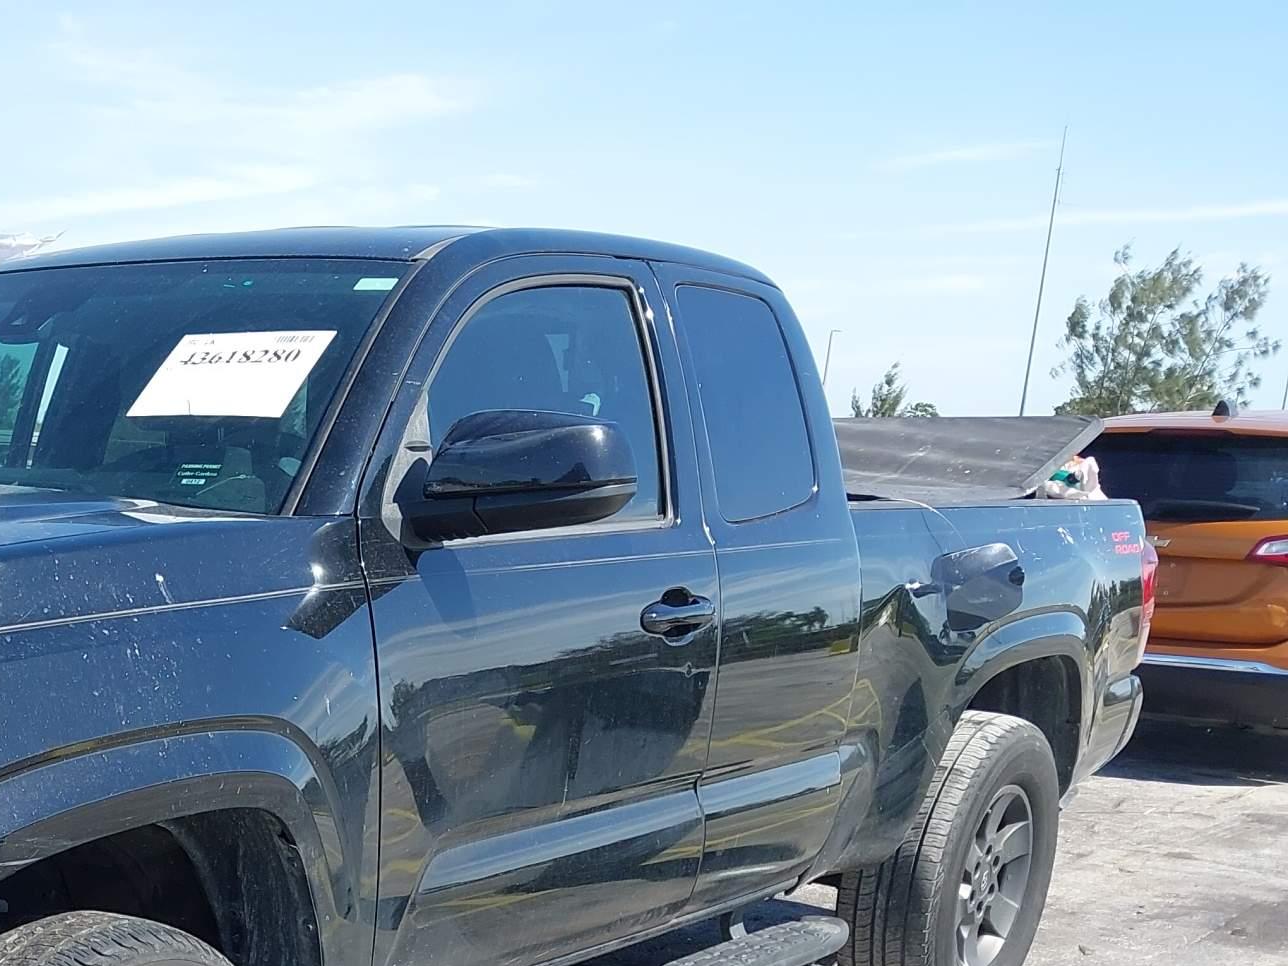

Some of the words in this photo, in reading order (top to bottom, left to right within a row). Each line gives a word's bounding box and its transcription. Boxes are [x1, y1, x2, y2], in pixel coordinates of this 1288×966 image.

[179, 348, 301, 365] 43618280
[1111, 531, 1130, 542] OFF
[1115, 543, 1140, 554] ROAD
